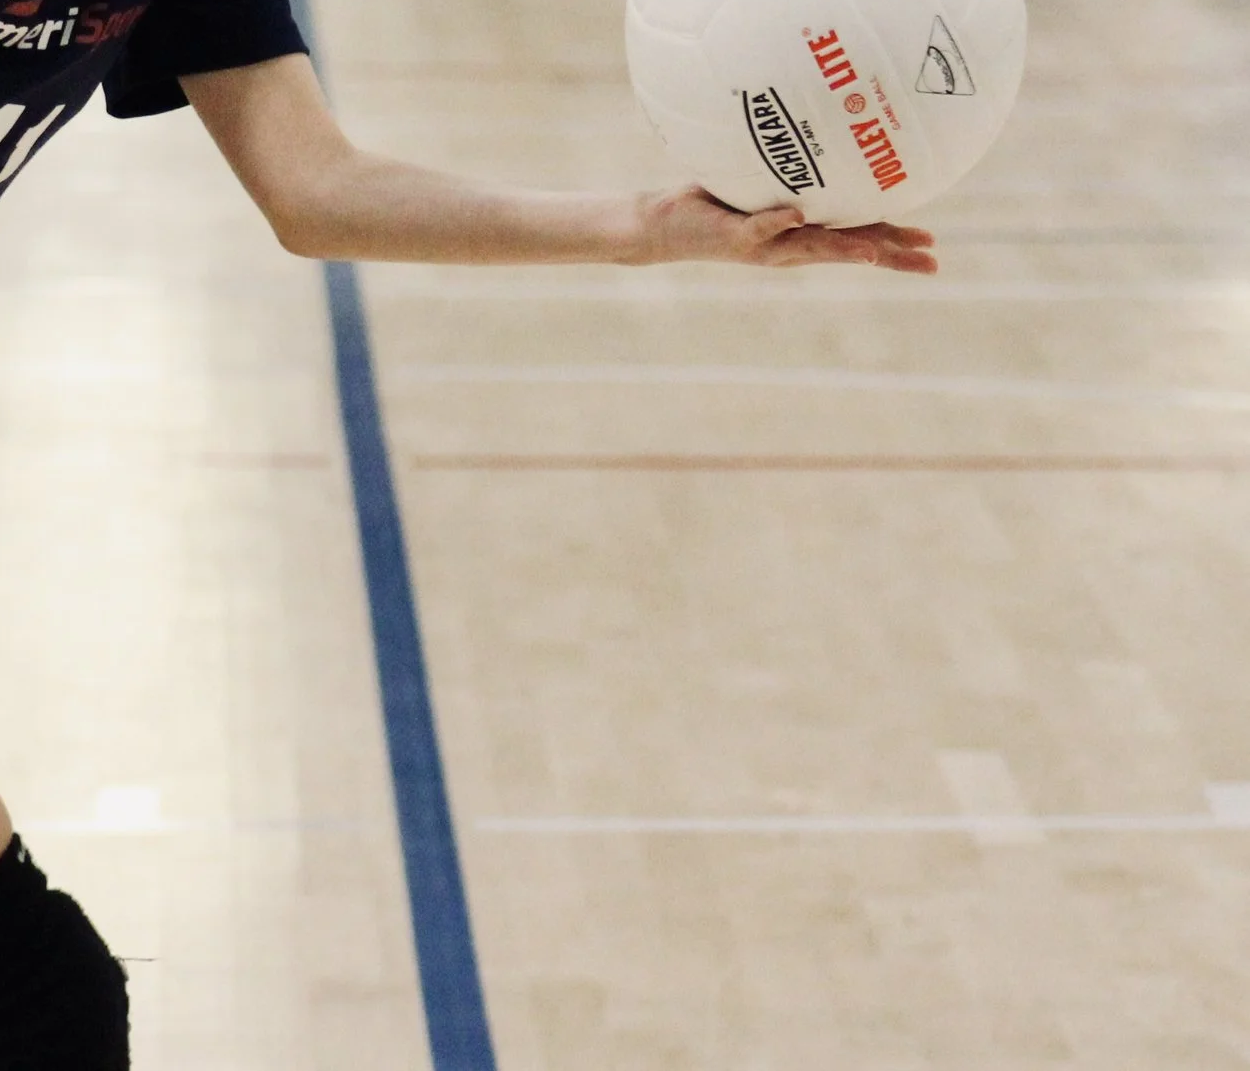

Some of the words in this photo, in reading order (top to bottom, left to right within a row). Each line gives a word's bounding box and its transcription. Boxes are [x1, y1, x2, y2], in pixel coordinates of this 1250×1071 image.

[806, 29, 858, 91] LITE
[869, 74, 887, 103] BALL
[751, 92, 814, 195] TACHIKARA
[882, 103, 902, 131] GAME
[849, 117, 908, 192] VOLLEY
